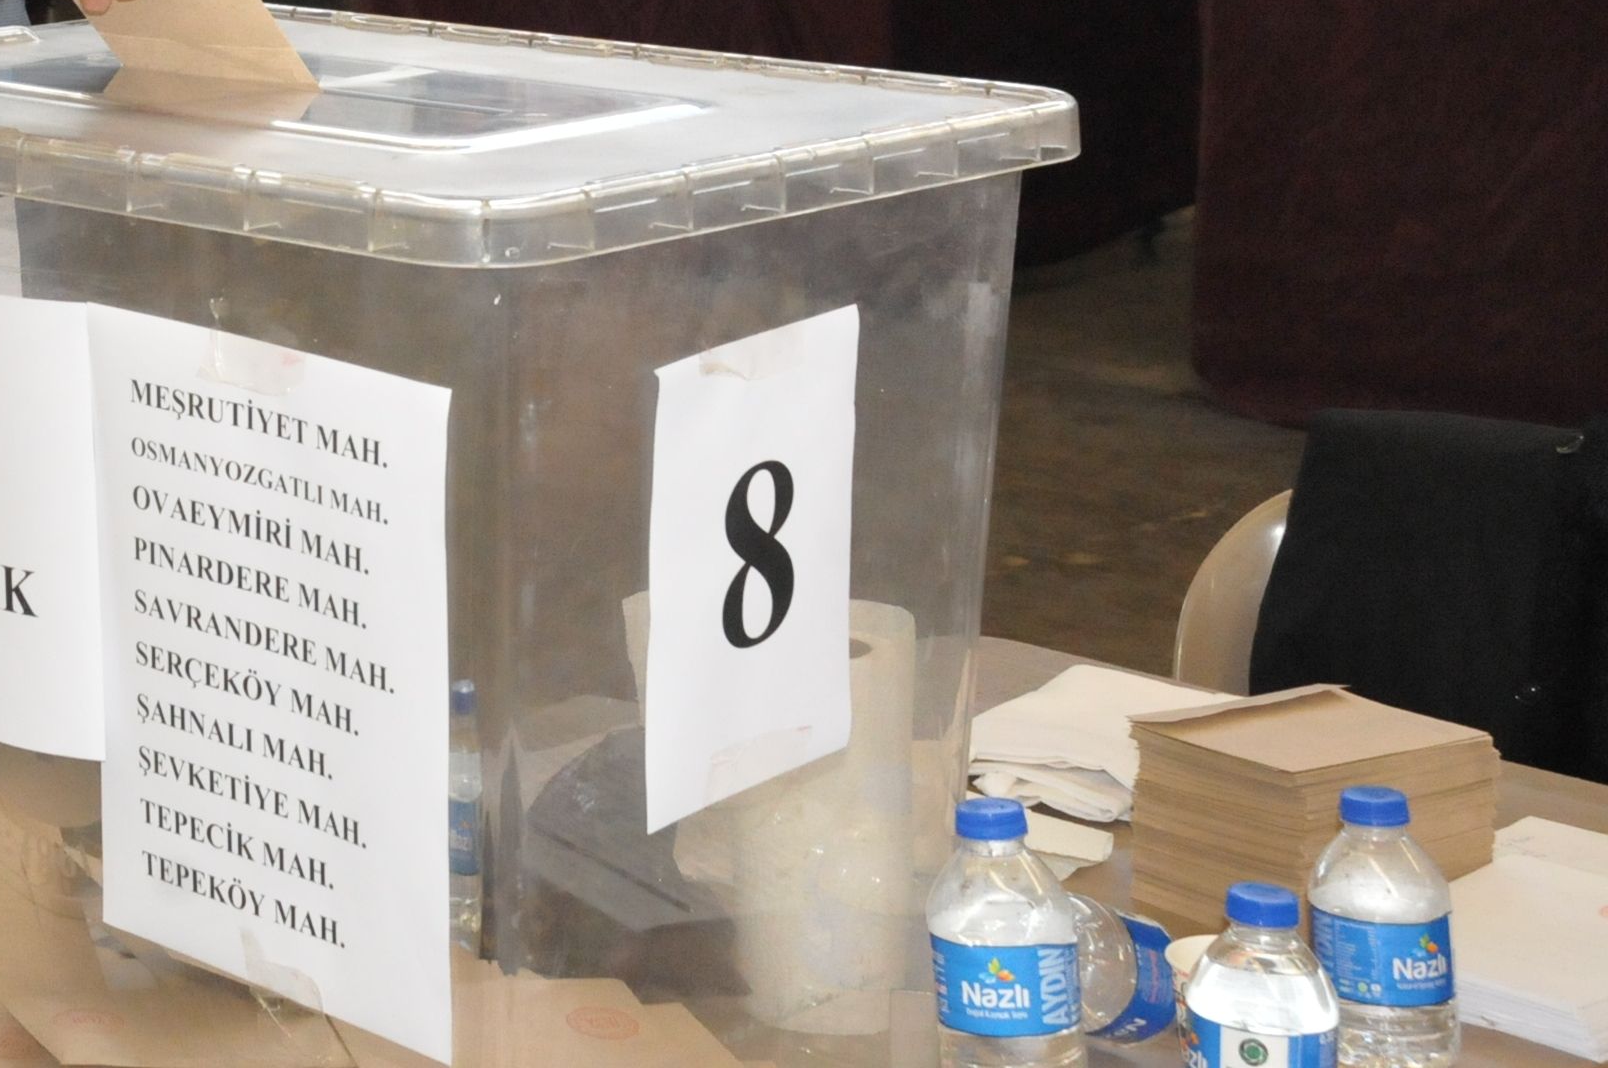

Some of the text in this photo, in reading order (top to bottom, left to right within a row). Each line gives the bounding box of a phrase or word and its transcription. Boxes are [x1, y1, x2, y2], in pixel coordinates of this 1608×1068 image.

[130, 379, 388, 469] MEŞRUTİYET MAH.
[131, 437, 389, 526] OSMANYOZGATLI MAH.
[133, 485, 370, 575] OVAEYMİRİ MAH.
[722, 460, 794, 649] 8
[134, 536, 367, 630] PINARDERE MAH.
[134, 589, 395, 694] SAVRANDERE MAH.
[135, 641, 359, 736] SERÇEKÖY MAH.
[136, 693, 333, 780] ŞAHNALI MAH.
[138, 745, 367, 849] ŞEVKETİYE MAH.
[140, 798, 334, 890] TEPECİK MAH.
[142, 850, 346, 949] TEPEKÖY MAH.
[961, 980, 1030, 1009] Nazlı
[1037, 948, 1069, 1025] AYDIN
